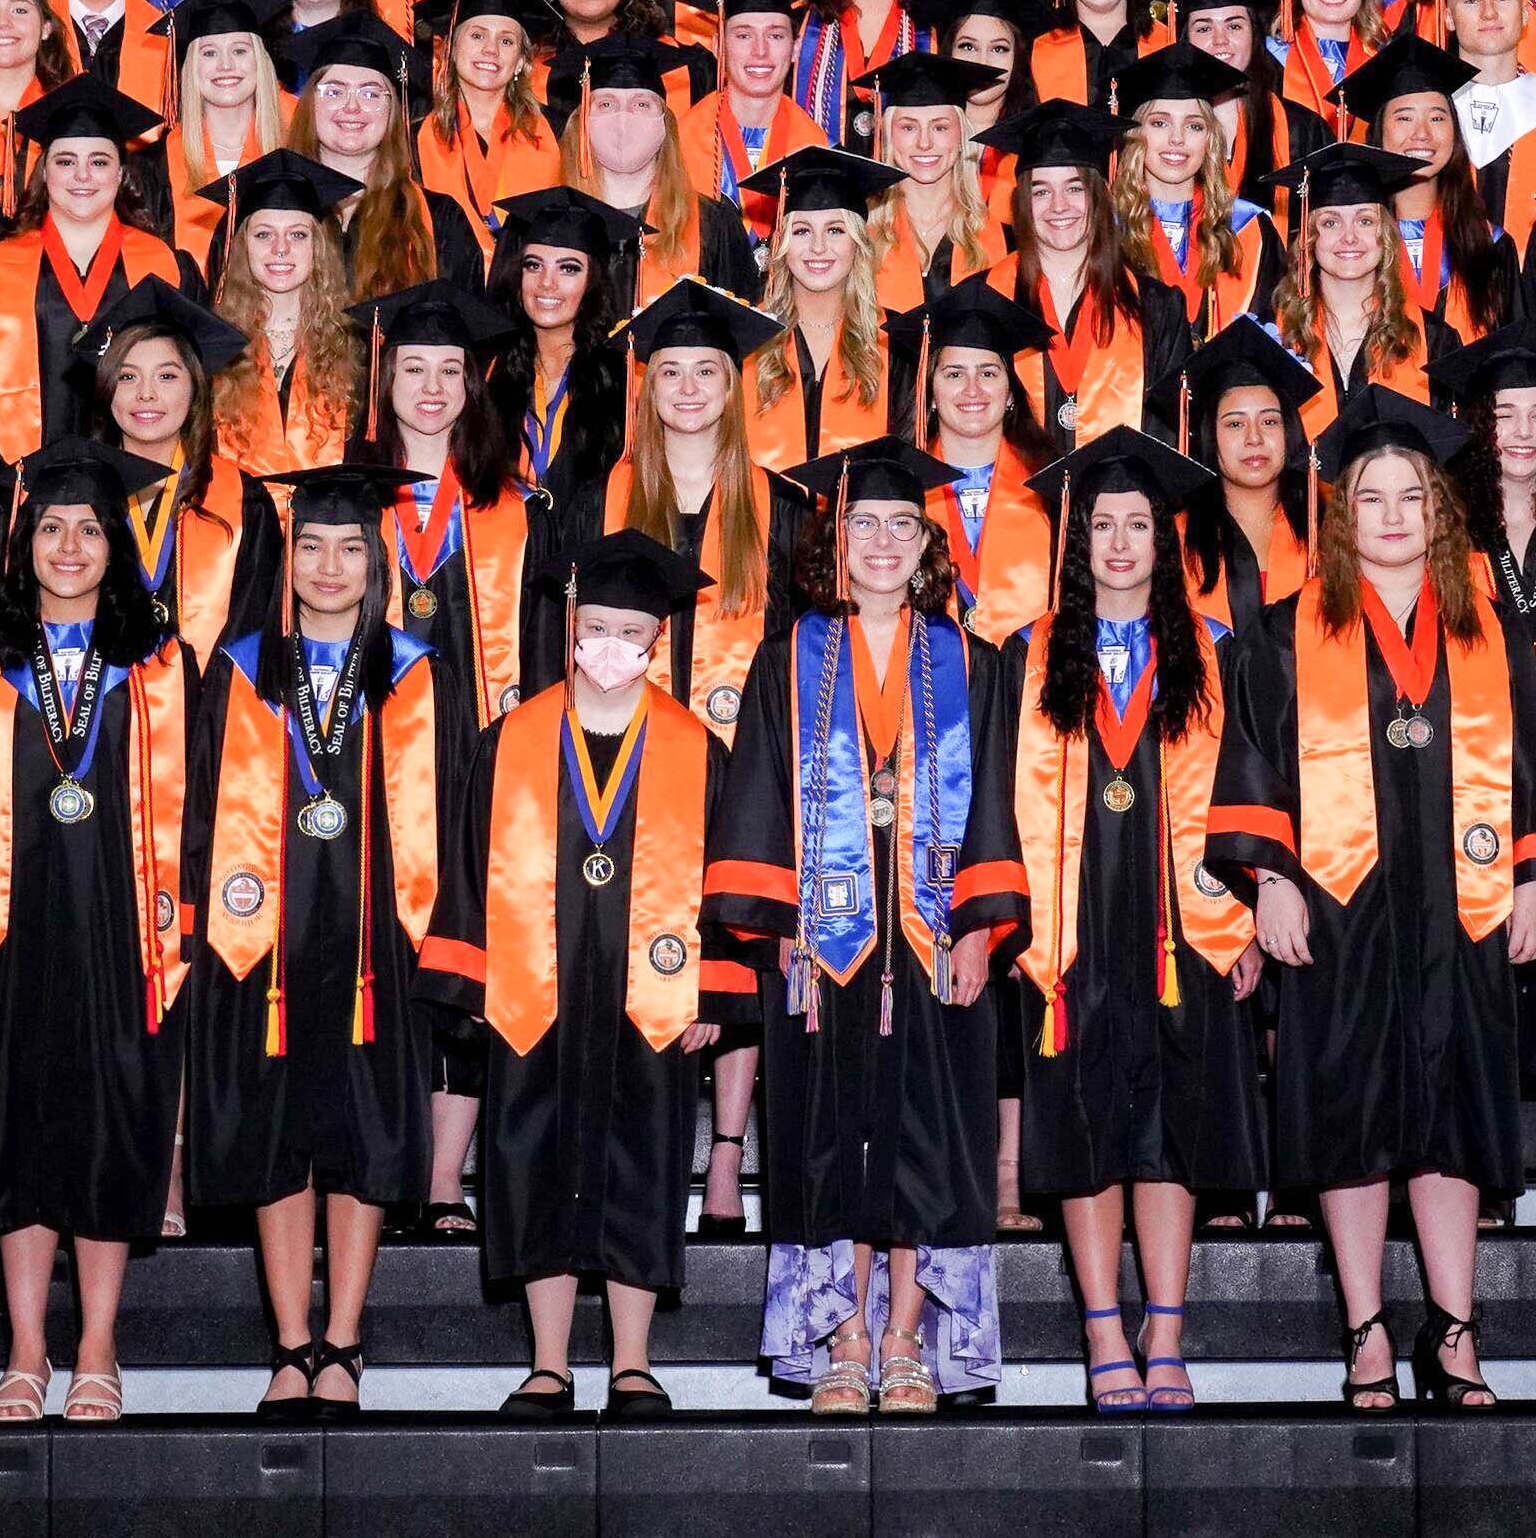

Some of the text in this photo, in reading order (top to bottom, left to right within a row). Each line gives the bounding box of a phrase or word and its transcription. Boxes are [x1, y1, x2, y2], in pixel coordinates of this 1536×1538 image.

[38, 673, 63, 743] BILITERACY
[72, 702, 91, 737] SEAL
[83, 685, 97, 701] OF
[298, 684, 323, 755] BILITERACY
[327, 721, 346, 756] SEAL
[337, 700, 349, 720] OF
